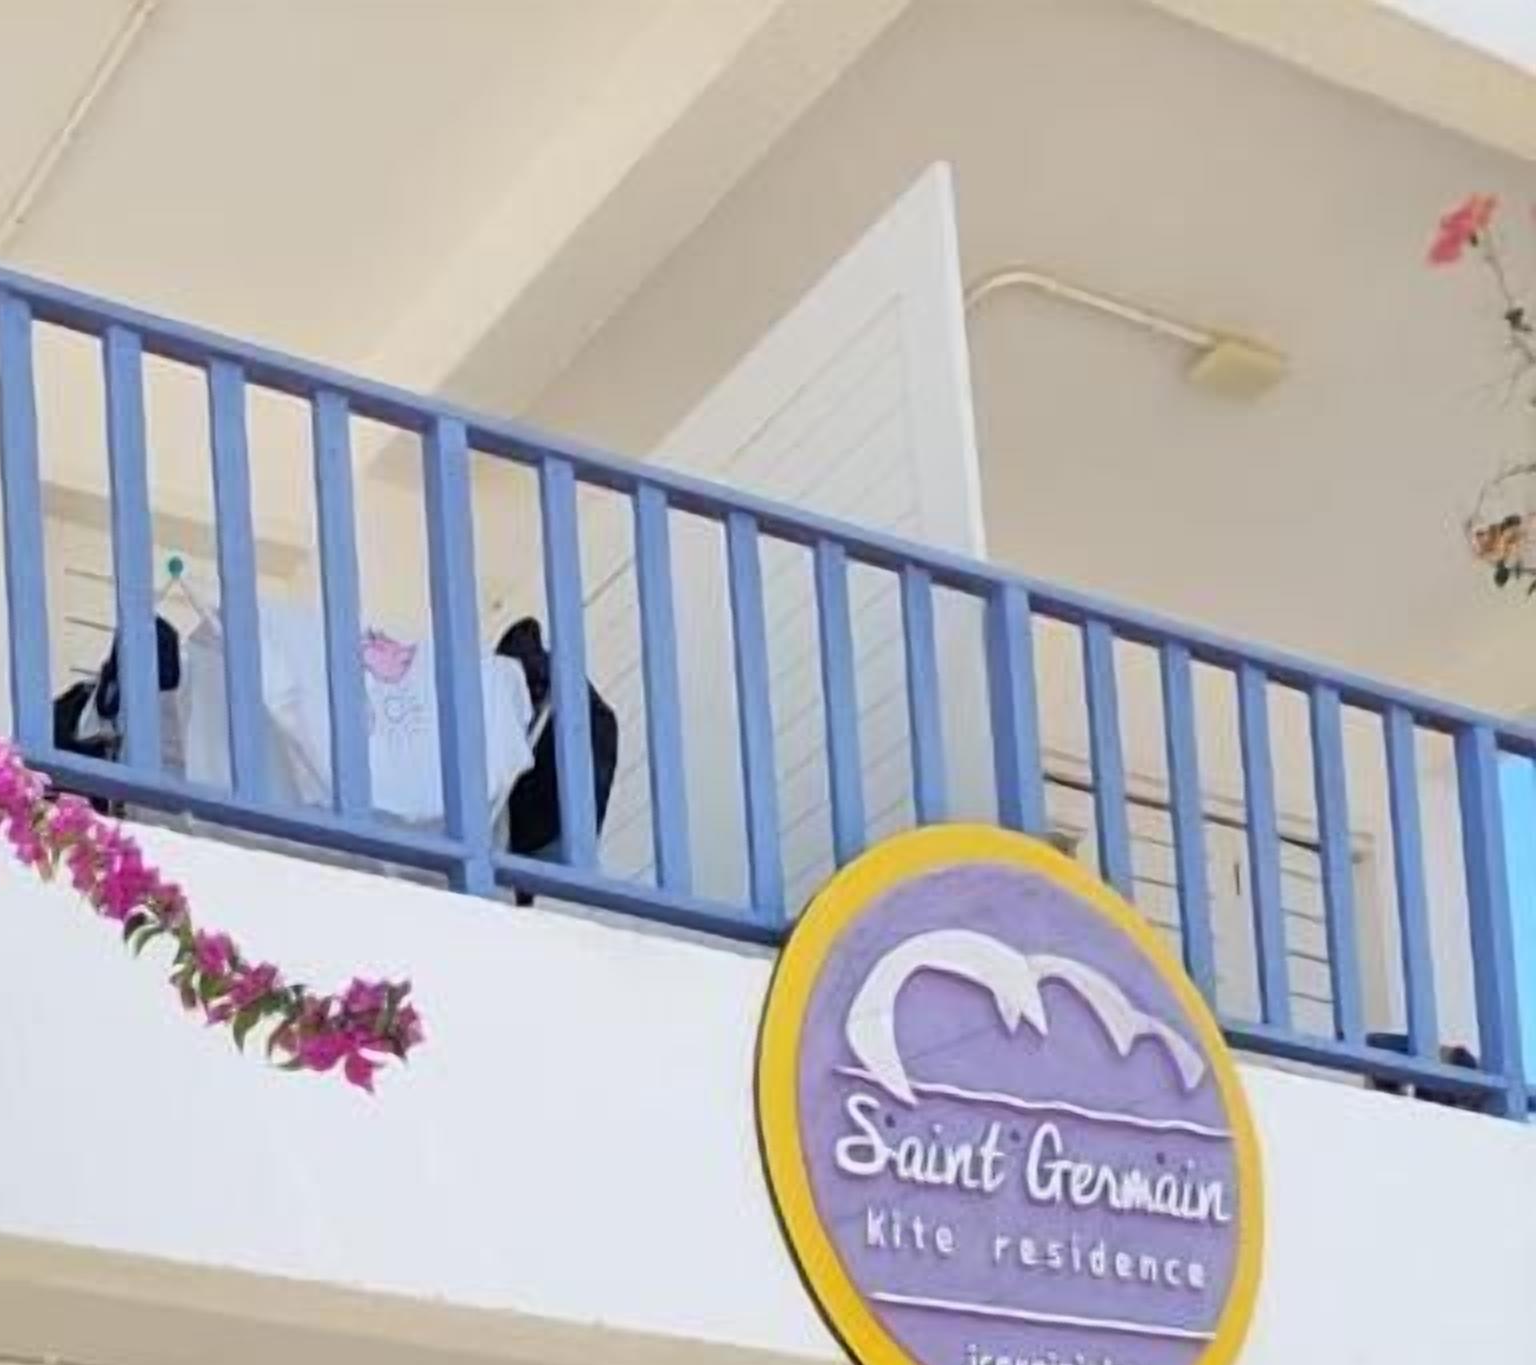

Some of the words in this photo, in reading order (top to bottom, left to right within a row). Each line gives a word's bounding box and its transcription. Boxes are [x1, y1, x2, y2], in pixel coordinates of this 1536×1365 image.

[835, 1094, 1006, 1193] Saint
[1025, 1121, 1232, 1223] Germain
[866, 1206, 956, 1254] Kite
[994, 1231, 1206, 1289] residence
